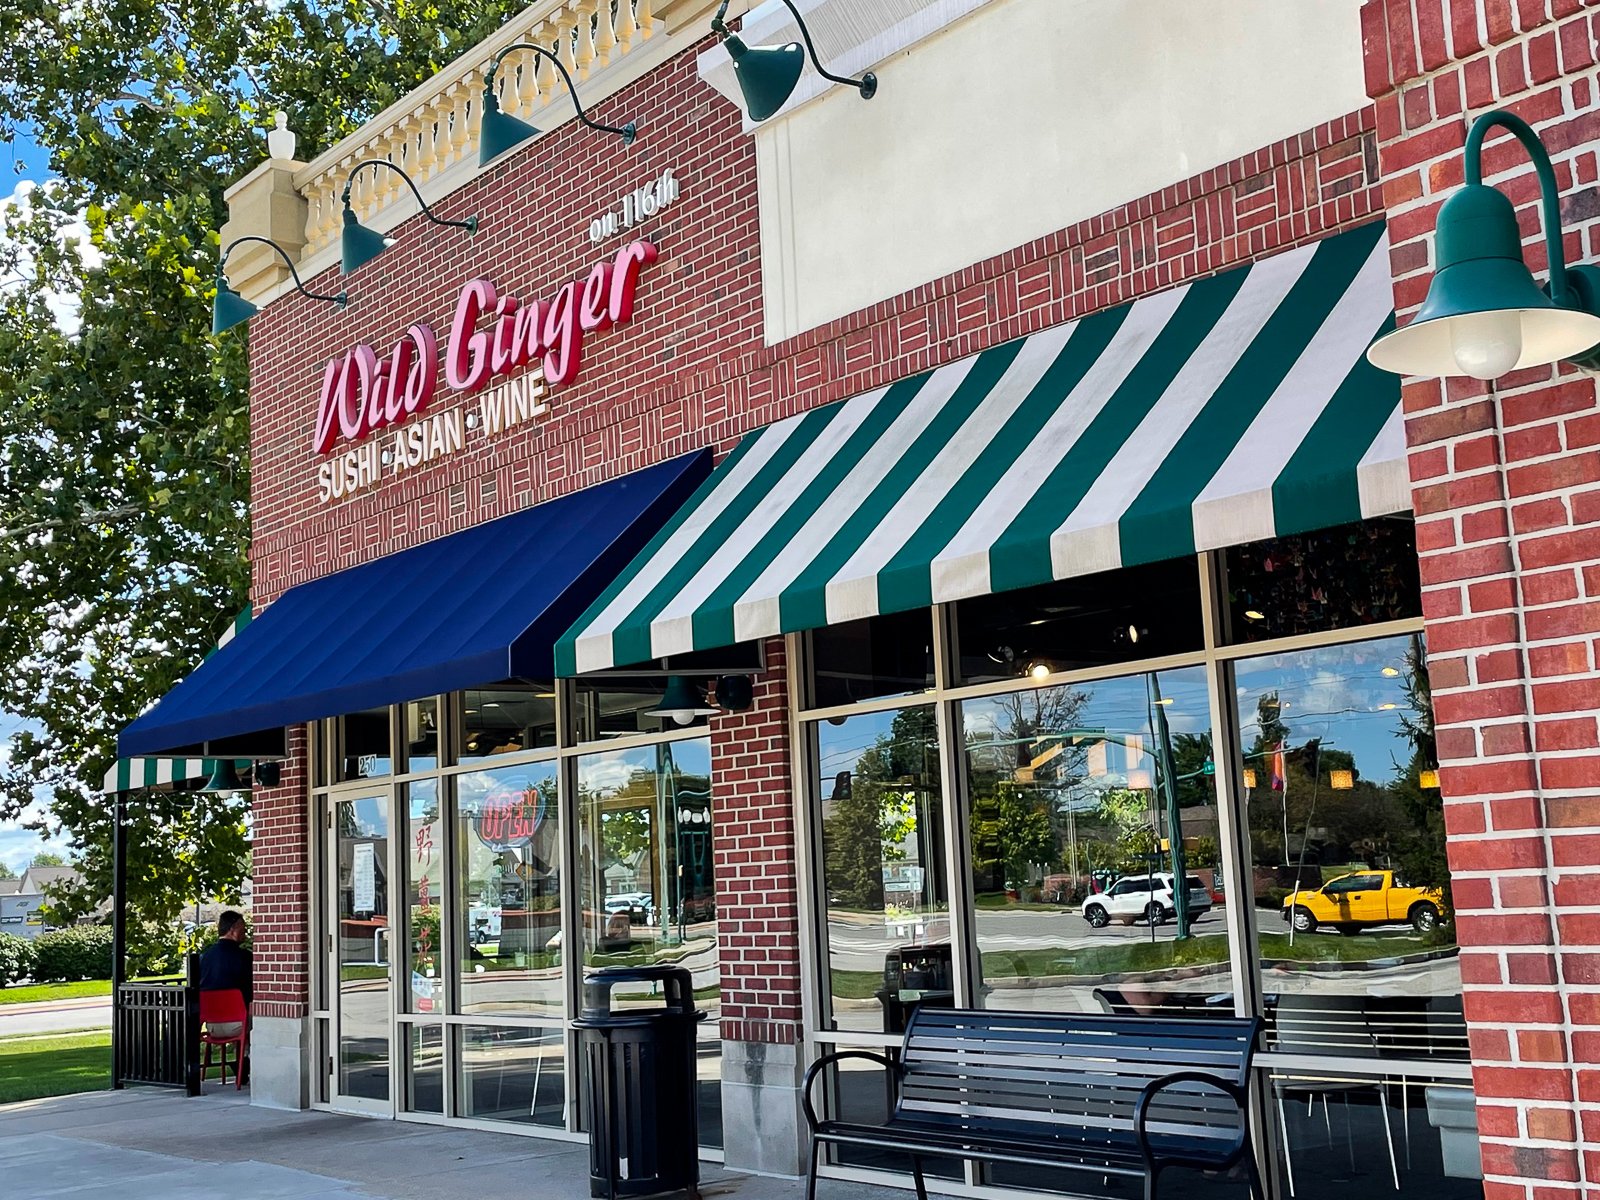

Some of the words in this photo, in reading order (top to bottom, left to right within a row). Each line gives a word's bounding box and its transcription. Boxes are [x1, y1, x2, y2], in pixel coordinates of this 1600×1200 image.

[590, 212, 618, 242] on
[622, 167, 680, 227] 116th
[313, 324, 437, 454] Wild
[445, 241, 658, 393] Ginger
[318, 442, 382, 502] SUSHI
[393, 407, 466, 473] ASIAN
[479, 369, 551, 438] WINE
[359, 756, 376, 774] 250
[482, 789, 538, 840] OPEN
